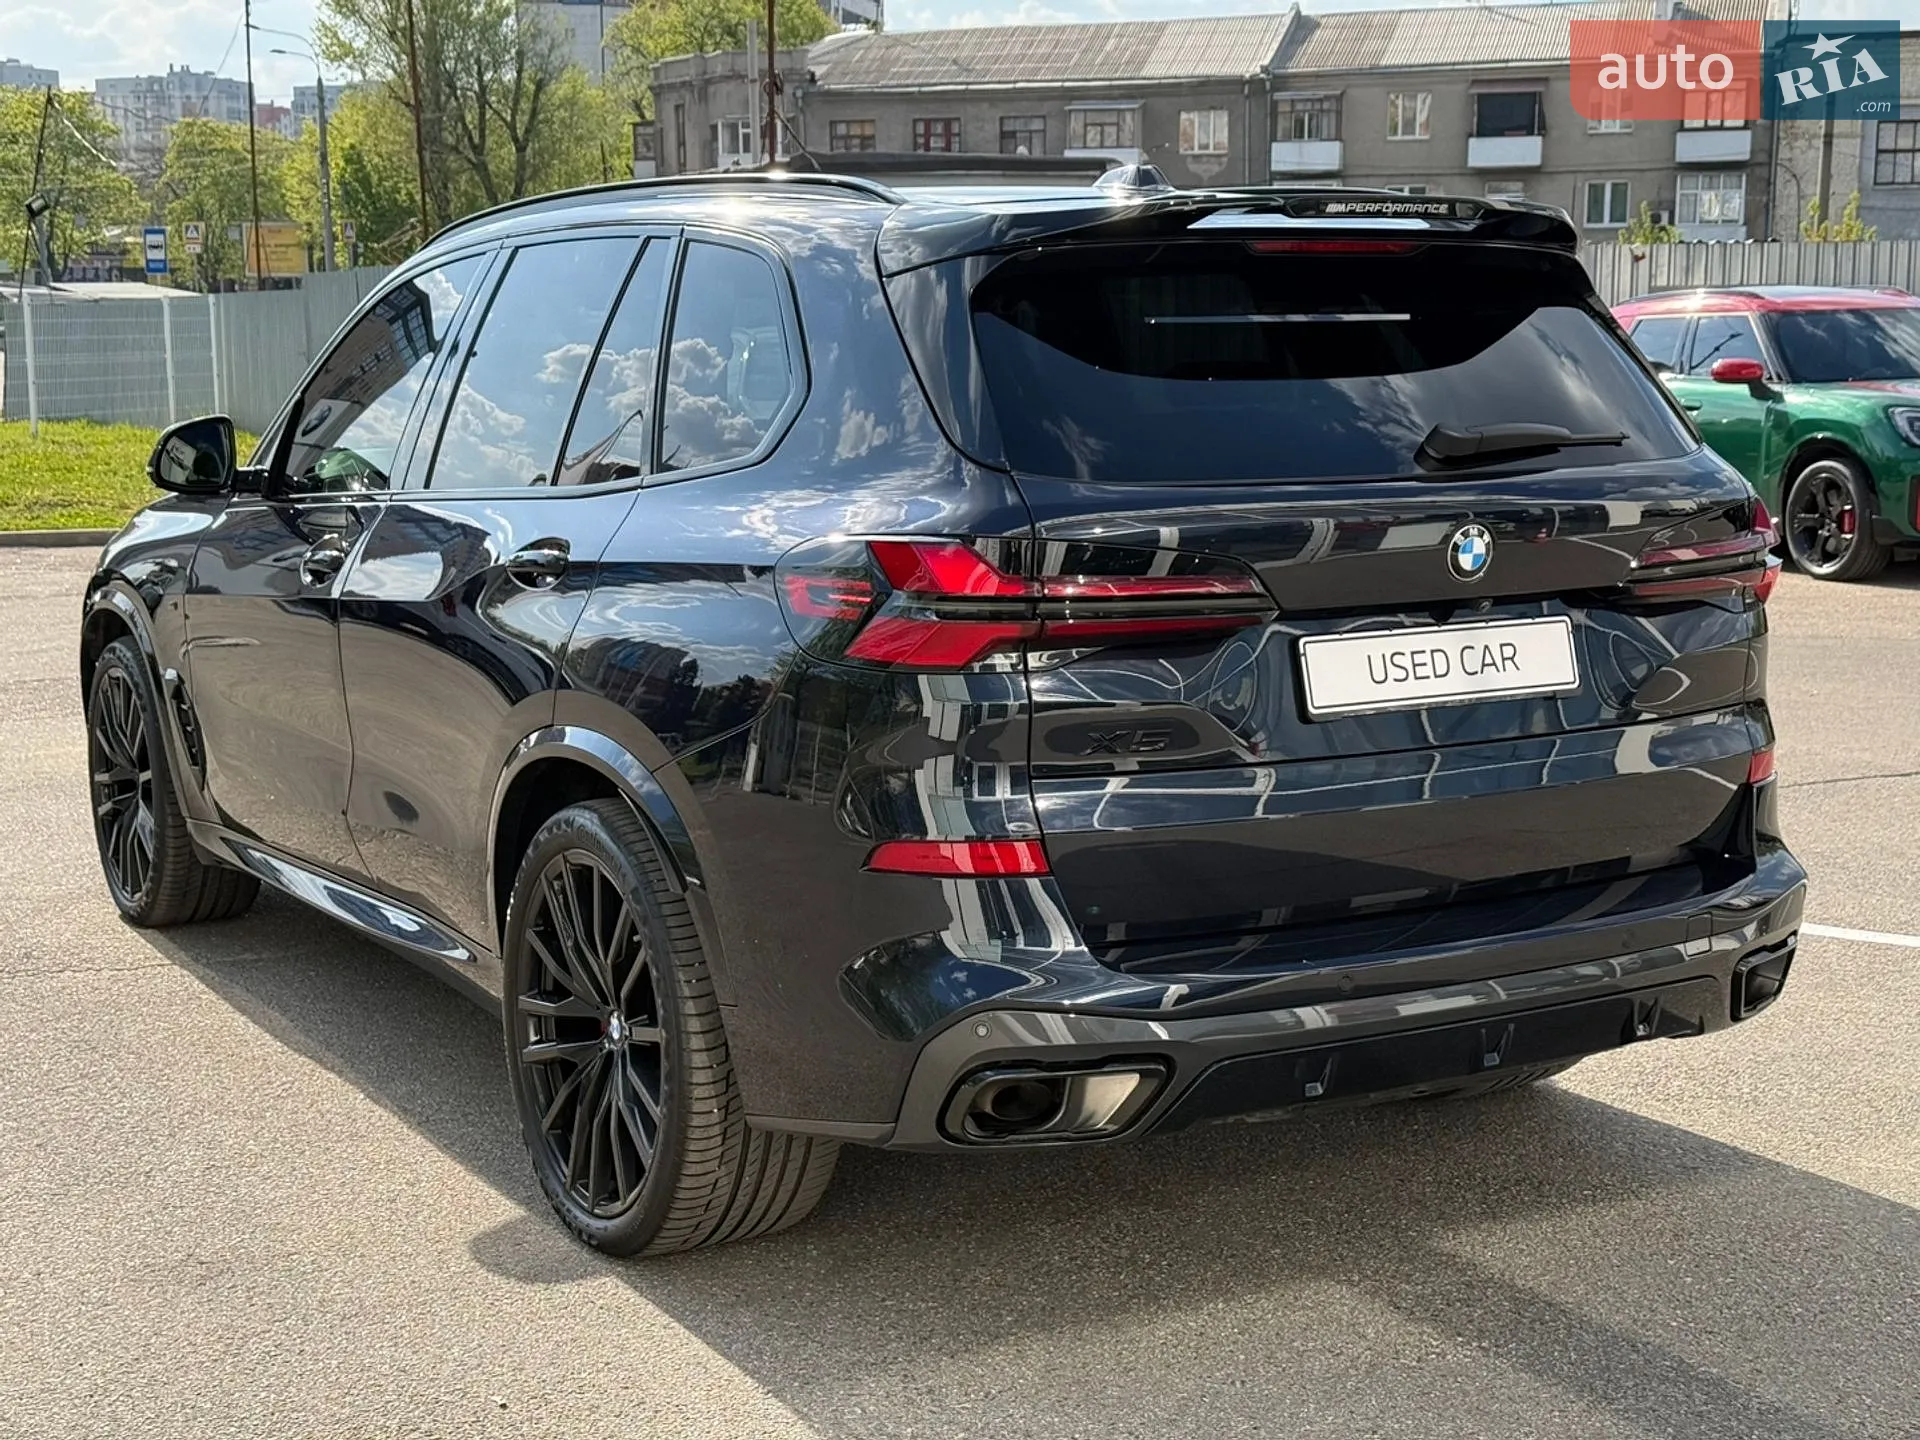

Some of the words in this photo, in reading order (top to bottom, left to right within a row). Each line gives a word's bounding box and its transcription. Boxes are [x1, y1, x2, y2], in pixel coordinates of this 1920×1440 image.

[1345, 202, 1449, 214] PERFORMANCE
[1454, 526, 1491, 547] BMW
[1367, 648, 1451, 685] USED
[1459, 641, 1521, 677] CAR
[1078, 729, 1173, 756] X5
